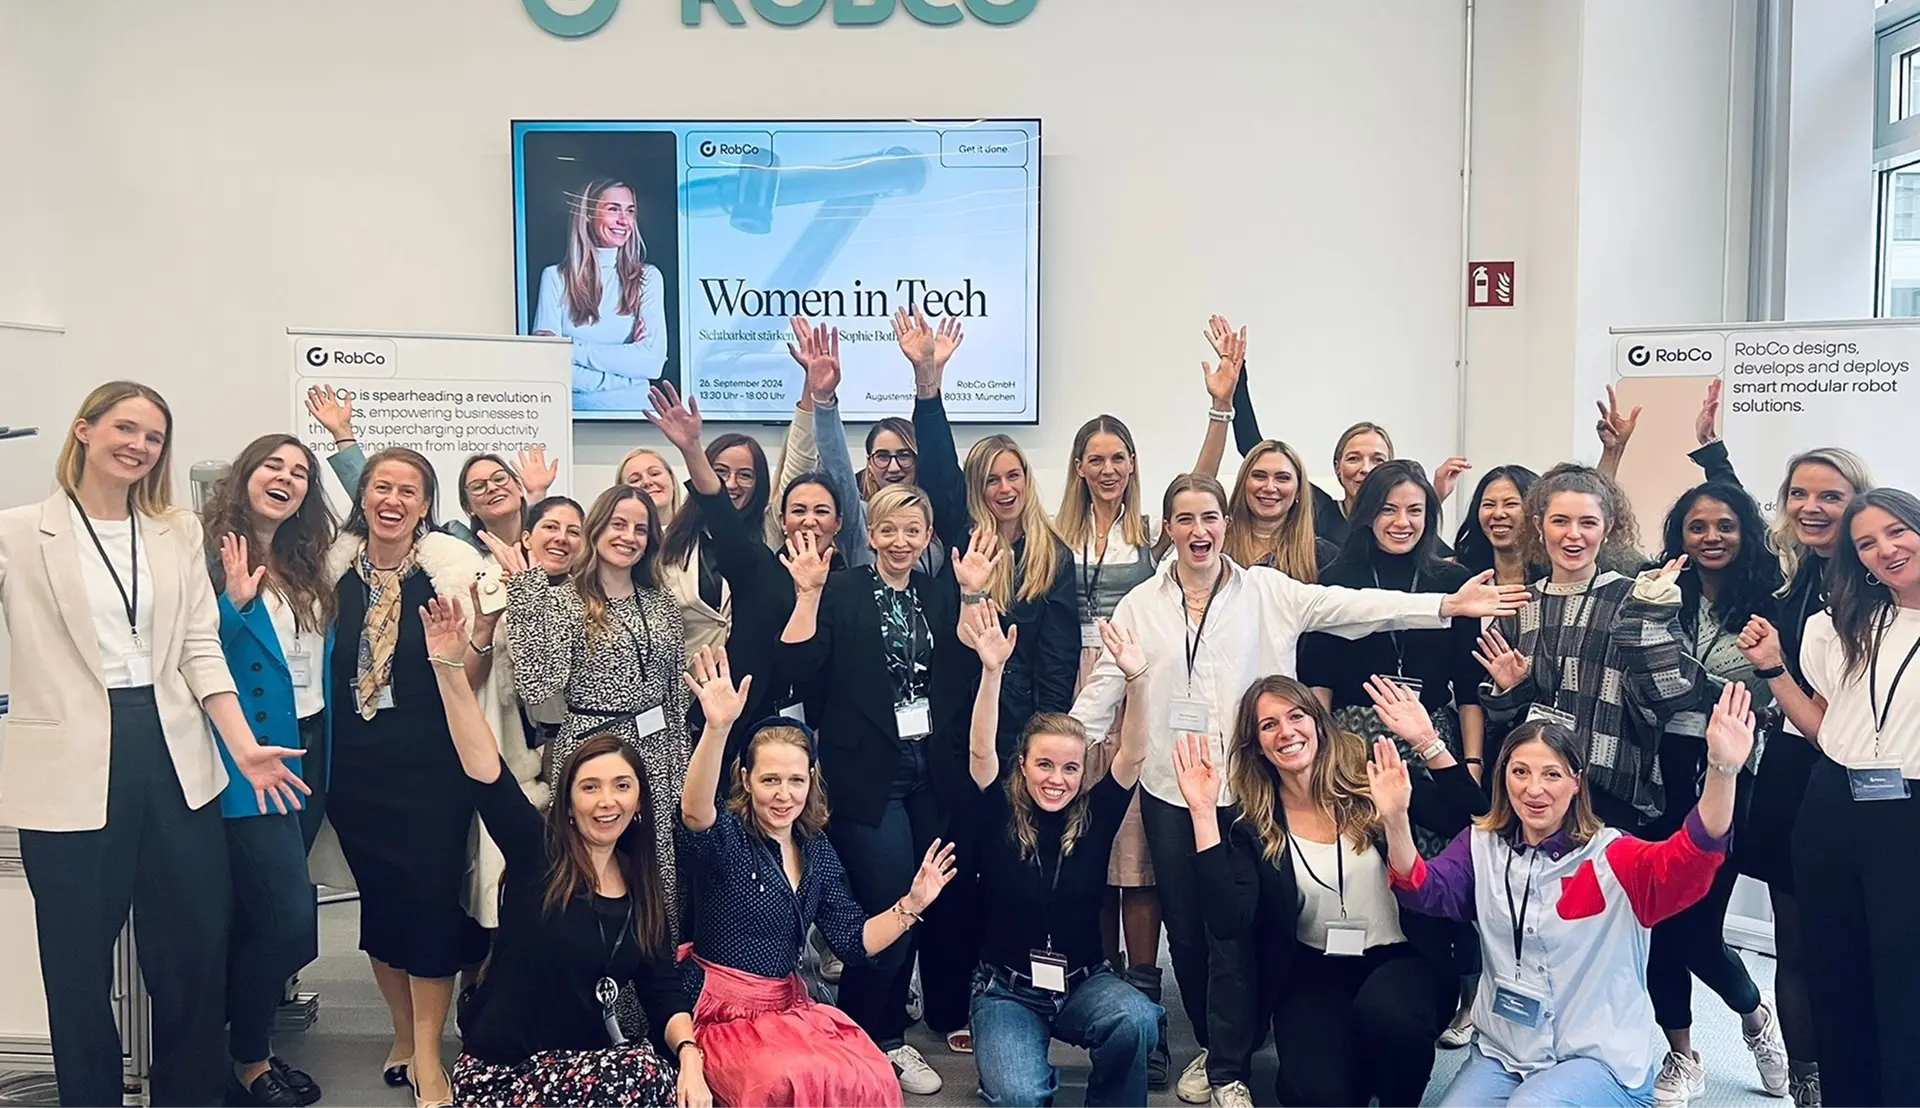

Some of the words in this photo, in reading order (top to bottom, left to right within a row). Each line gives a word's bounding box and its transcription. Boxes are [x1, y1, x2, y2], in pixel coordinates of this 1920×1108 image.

[720, 143, 759, 156] RobCo
[958, 144, 976, 154] Get
[699, 279, 845, 317] Women
[853, 279, 888, 317] in
[896, 279, 988, 318] Tech
[699, 330, 756, 342] Sichtbarkeit
[757, 330, 794, 341] stärken
[839, 330, 874, 343] Sophie
[1655, 348, 1712, 363] RobCo
[1734, 341, 1790, 356] RobCo
[1792, 341, 1859, 359] designs,
[333, 351, 386, 365] RobCo
[1733, 359, 1805, 377] develops
[1807, 359, 1845, 373] and
[1846, 357, 1909, 375] deploys
[713, 379, 760, 389] September
[762, 379, 783, 388] 2024
[957, 380, 986, 390] RobCo
[988, 380, 1015, 390] GmbH
[1732, 380, 1777, 394] smart
[1780, 379, 1849, 393] modular
[1852, 377, 1898, 393] robot
[359, 389, 370, 401] is
[372, 390, 463, 404] spearheading
[466, 393, 474, 402] a
[477, 391, 538, 404] revolution
[541, 392, 552, 404] in
[723, 391, 739, 400] Uhr
[770, 392, 786, 400] Uhr
[1732, 398, 1805, 413] solutions.
[369, 407, 452, 421] empowering
[454, 407, 524, 420] businesses
[527, 410, 538, 420] to
[368, 424, 464, 438] supercharging
[466, 425, 539, 439] productivity
[310, 440, 335, 451] and
[425, 440, 455, 451] from
[457, 440, 489, 451] labor
